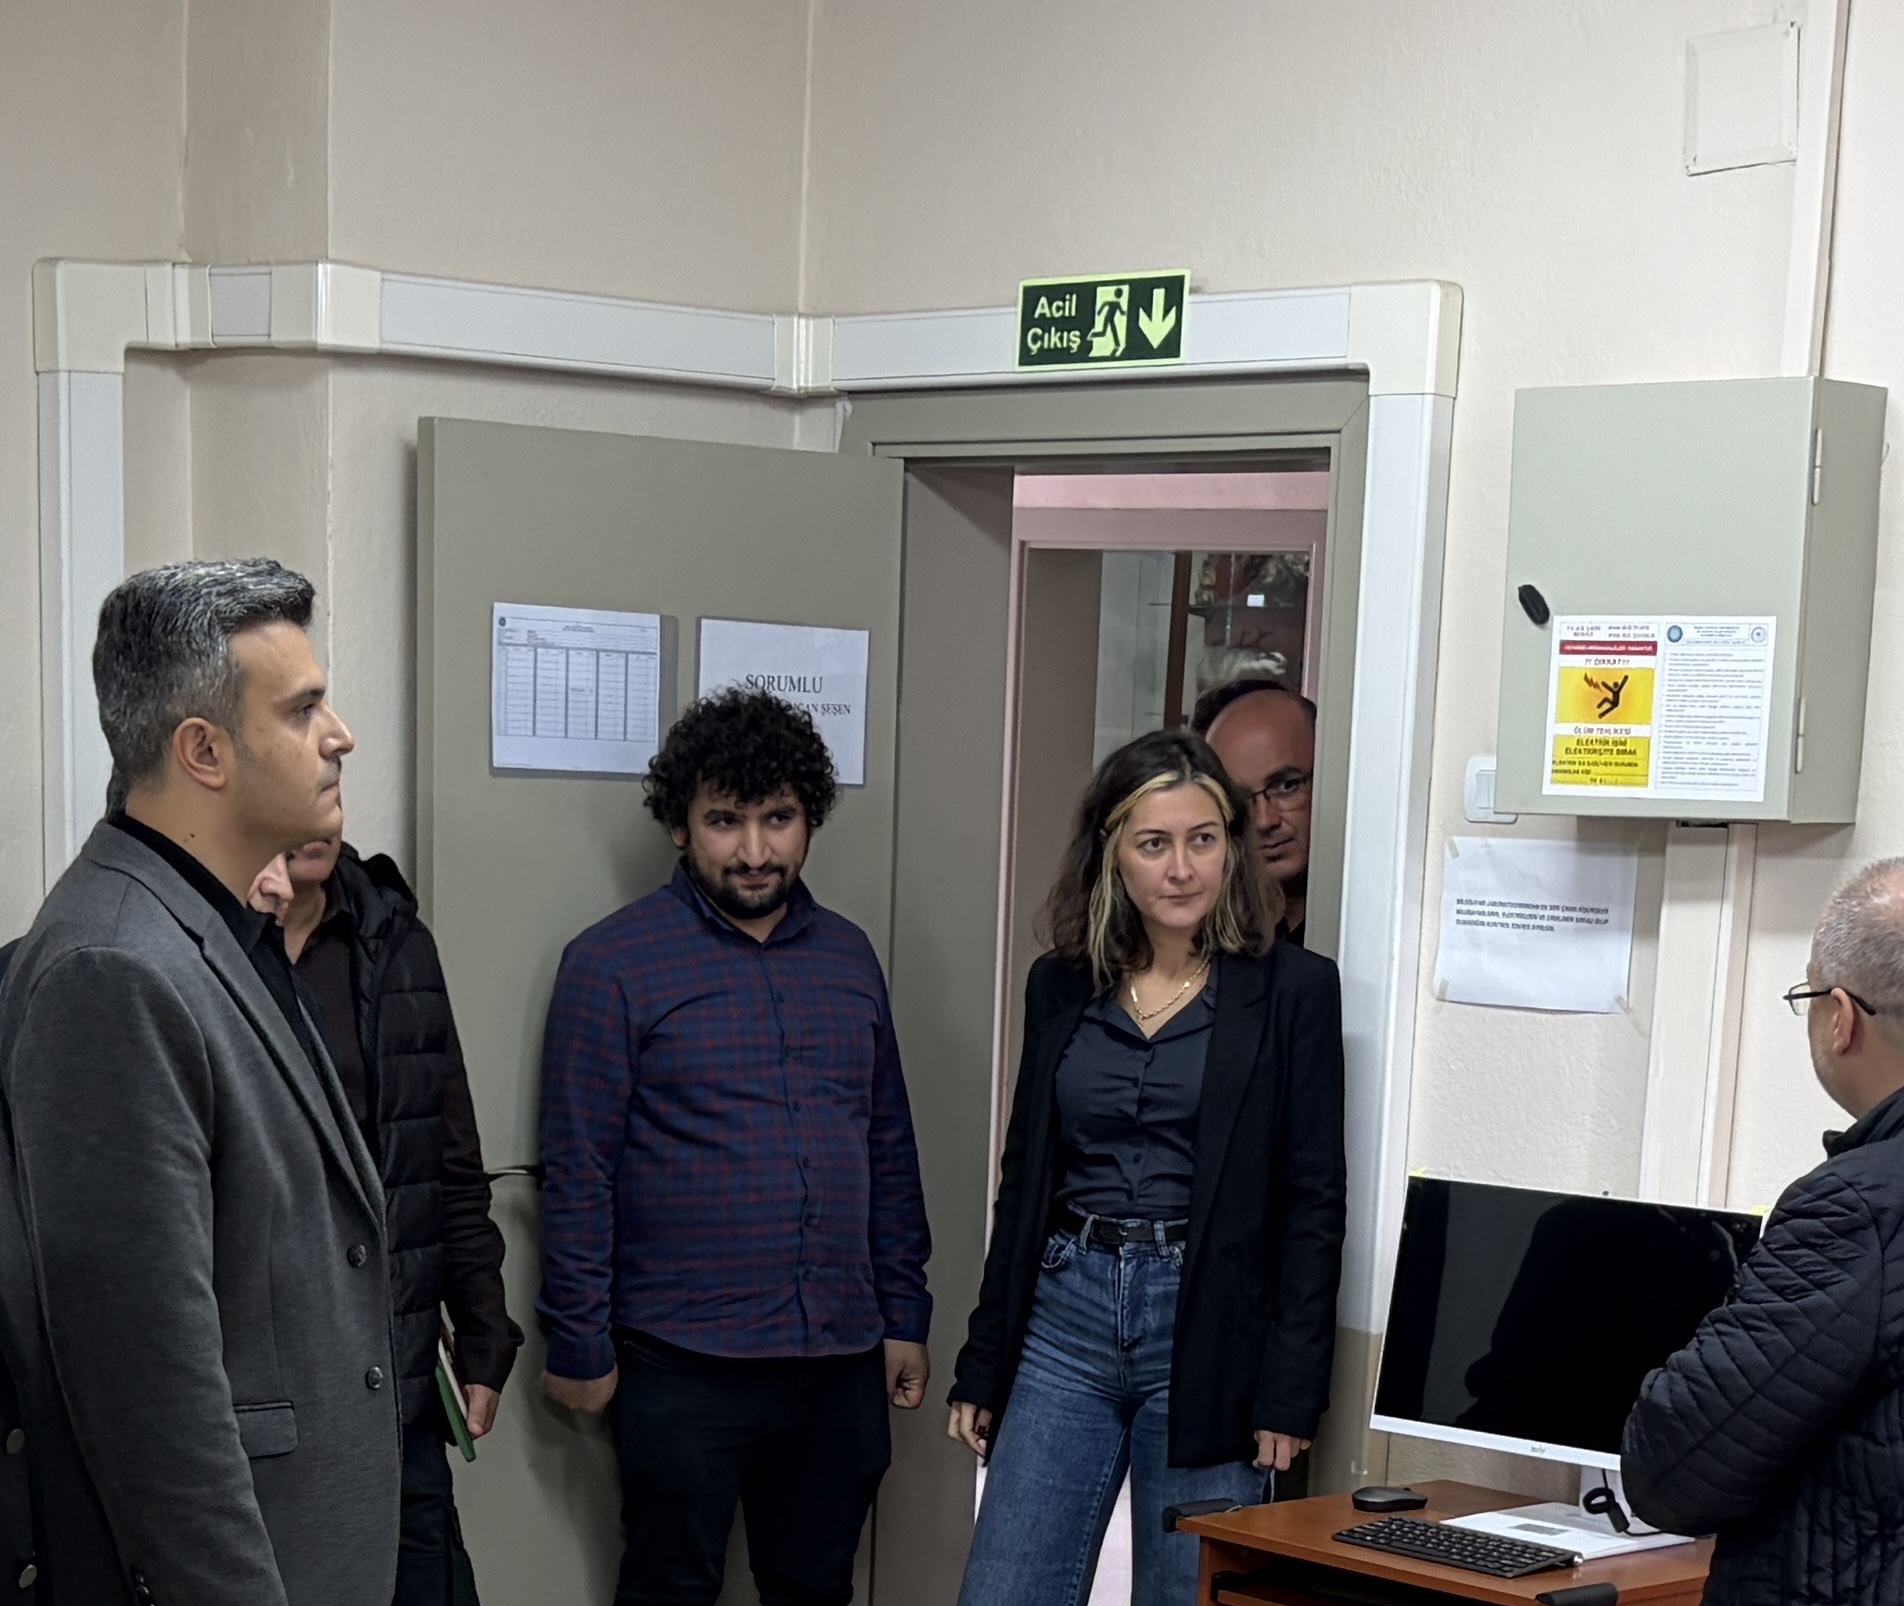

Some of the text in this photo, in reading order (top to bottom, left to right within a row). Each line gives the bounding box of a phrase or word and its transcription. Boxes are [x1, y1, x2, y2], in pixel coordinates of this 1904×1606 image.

[1033, 293, 1077, 319] Acil
[1027, 326, 1081, 355] Çıkış
[744, 674, 823, 694] SORUMLU
